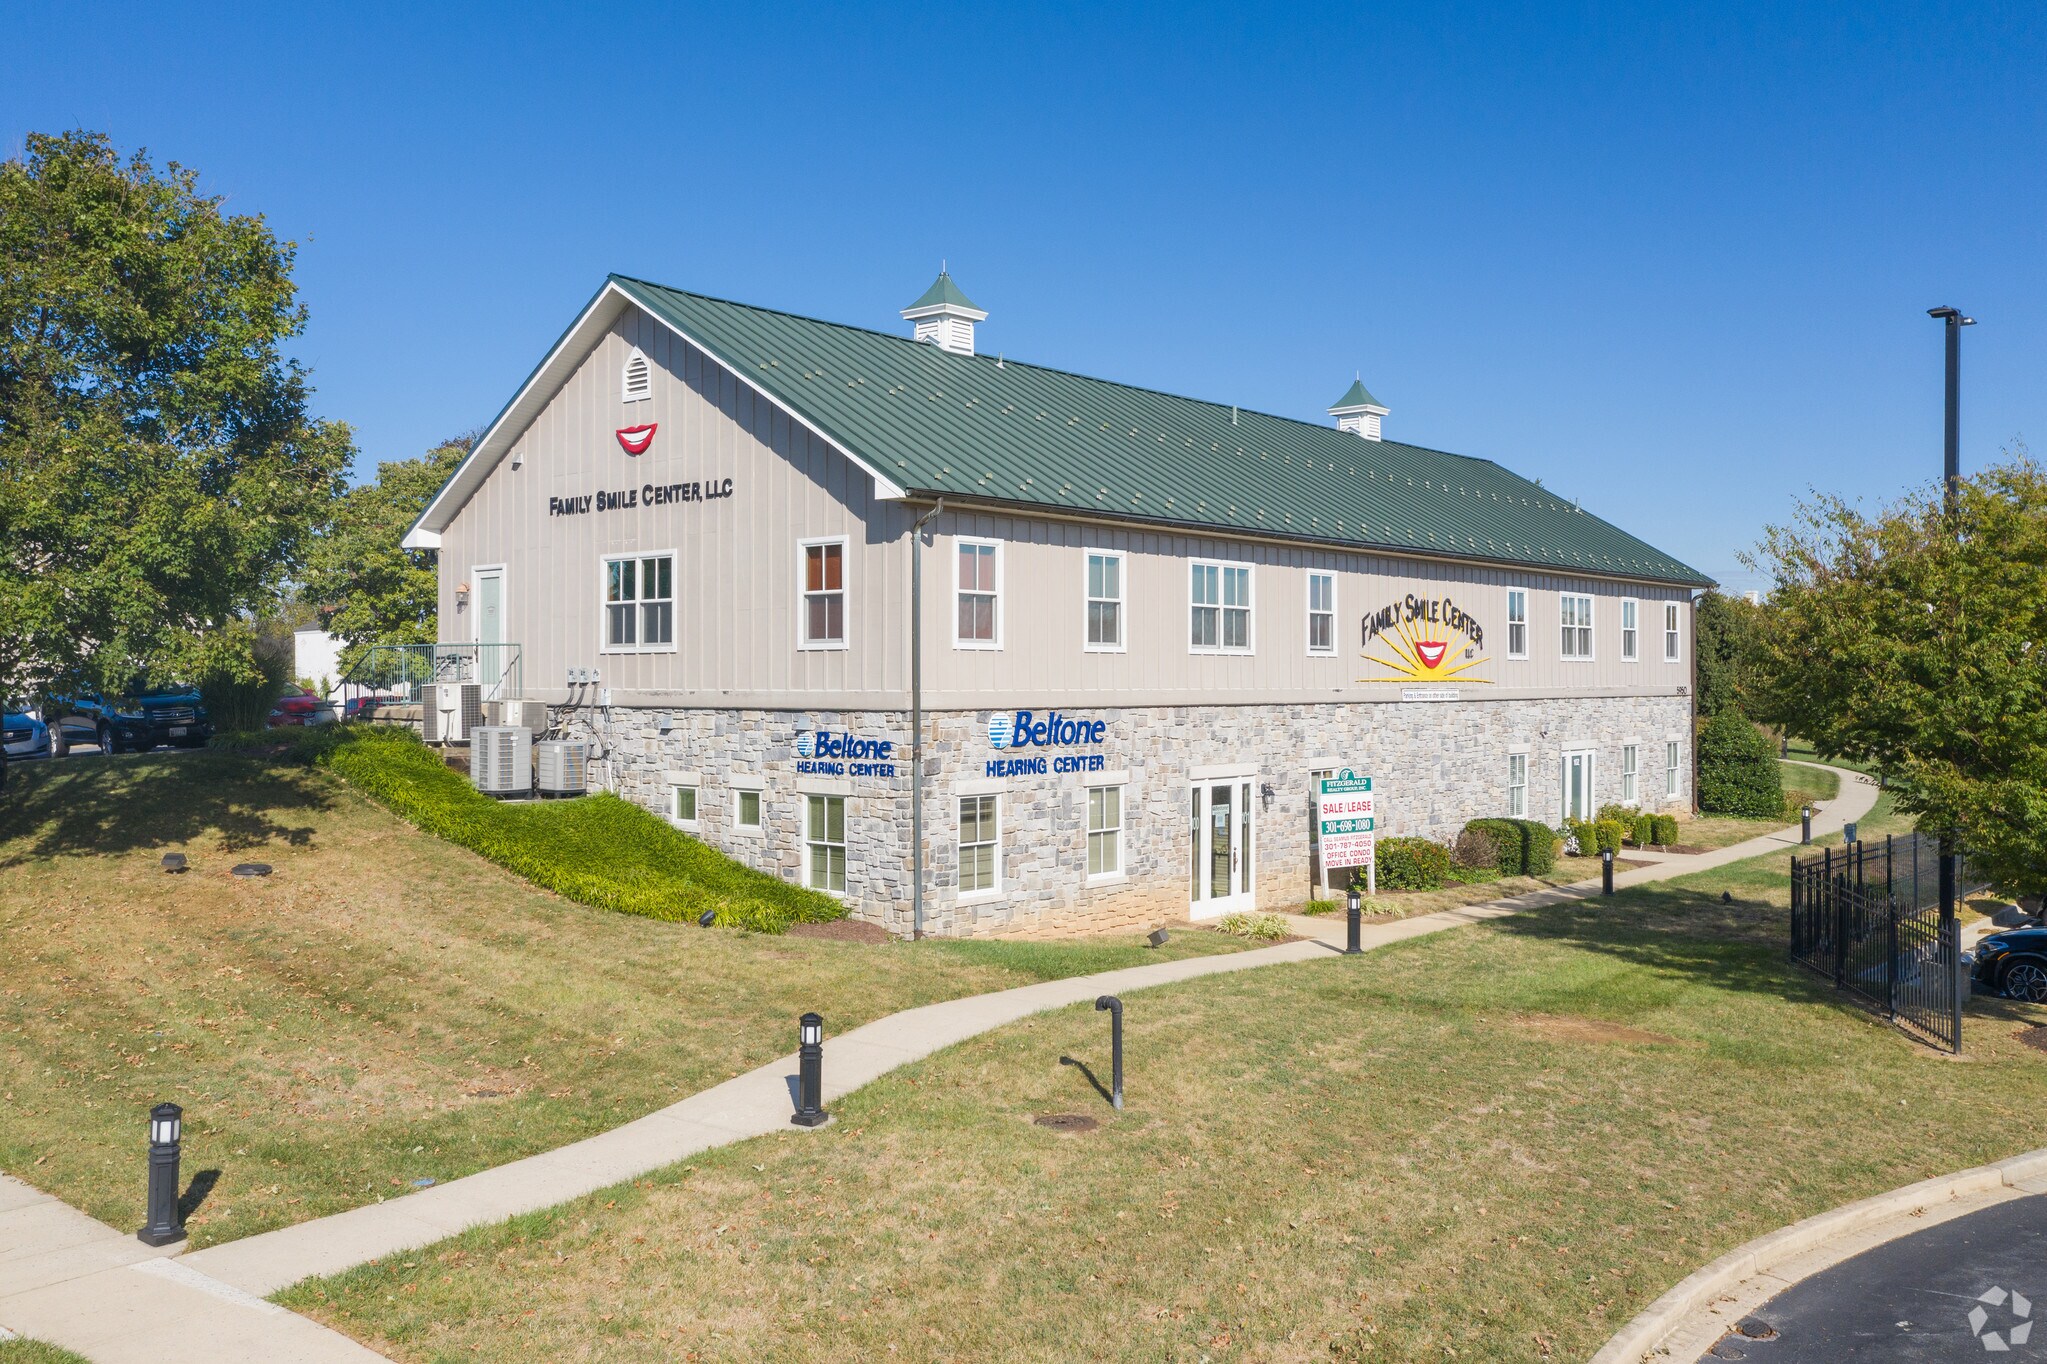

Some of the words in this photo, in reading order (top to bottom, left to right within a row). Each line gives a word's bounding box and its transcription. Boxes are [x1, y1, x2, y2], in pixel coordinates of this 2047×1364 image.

[549, 495, 592, 517] FAMILY
[596, 489, 638, 512] SMILE
[642, 482, 703, 507] CENTER,
[705, 478, 733, 500] LLC
[1361, 601, 1402, 648] FAMILY
[1405, 593, 1440, 623] SMILE
[1443, 598, 1483, 651] CENTER
[1465, 648, 1474, 659] LLC
[1010, 711, 1106, 747] Beltone
[815, 731, 892, 760] Beltone
[796, 761, 844, 776] HEARING
[849, 763, 895, 778] CENTER
[986, 757, 1047, 777] HEARING
[1053, 755, 1105, 774] CENTER
[1327, 779, 1367, 788] FITZGERALD
[1325, 819, 1371, 833] 301-698-1080
[1324, 840, 1372, 850] 301-787-4050
[1325, 859, 1343, 867] MOVE
[1353, 856, 1372, 864] READY
[1327, 851, 1347, 859] OFFICE
[1350, 849, 1371, 857] CONDO
